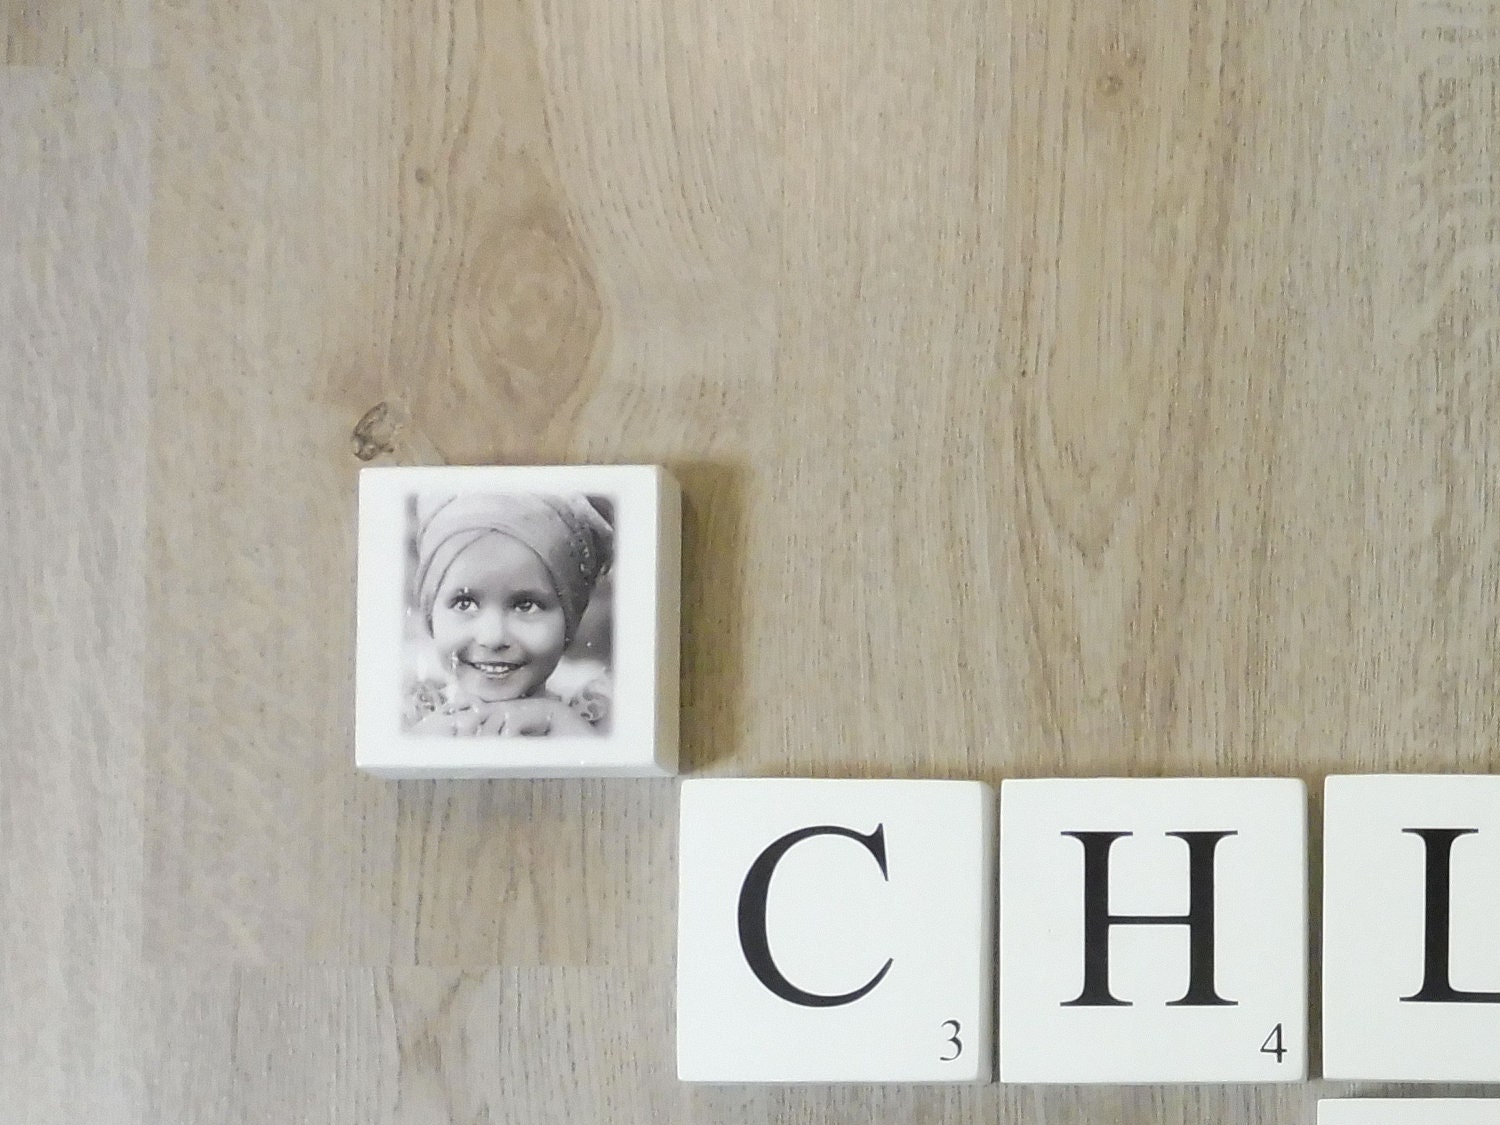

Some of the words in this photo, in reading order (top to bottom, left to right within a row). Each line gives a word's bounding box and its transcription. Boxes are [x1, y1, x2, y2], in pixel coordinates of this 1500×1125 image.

[736, 822, 895, 1008] C
[1059, 829, 1239, 1008] H
[939, 1019, 963, 1062] 3
[1259, 1022, 1288, 1064] 4
